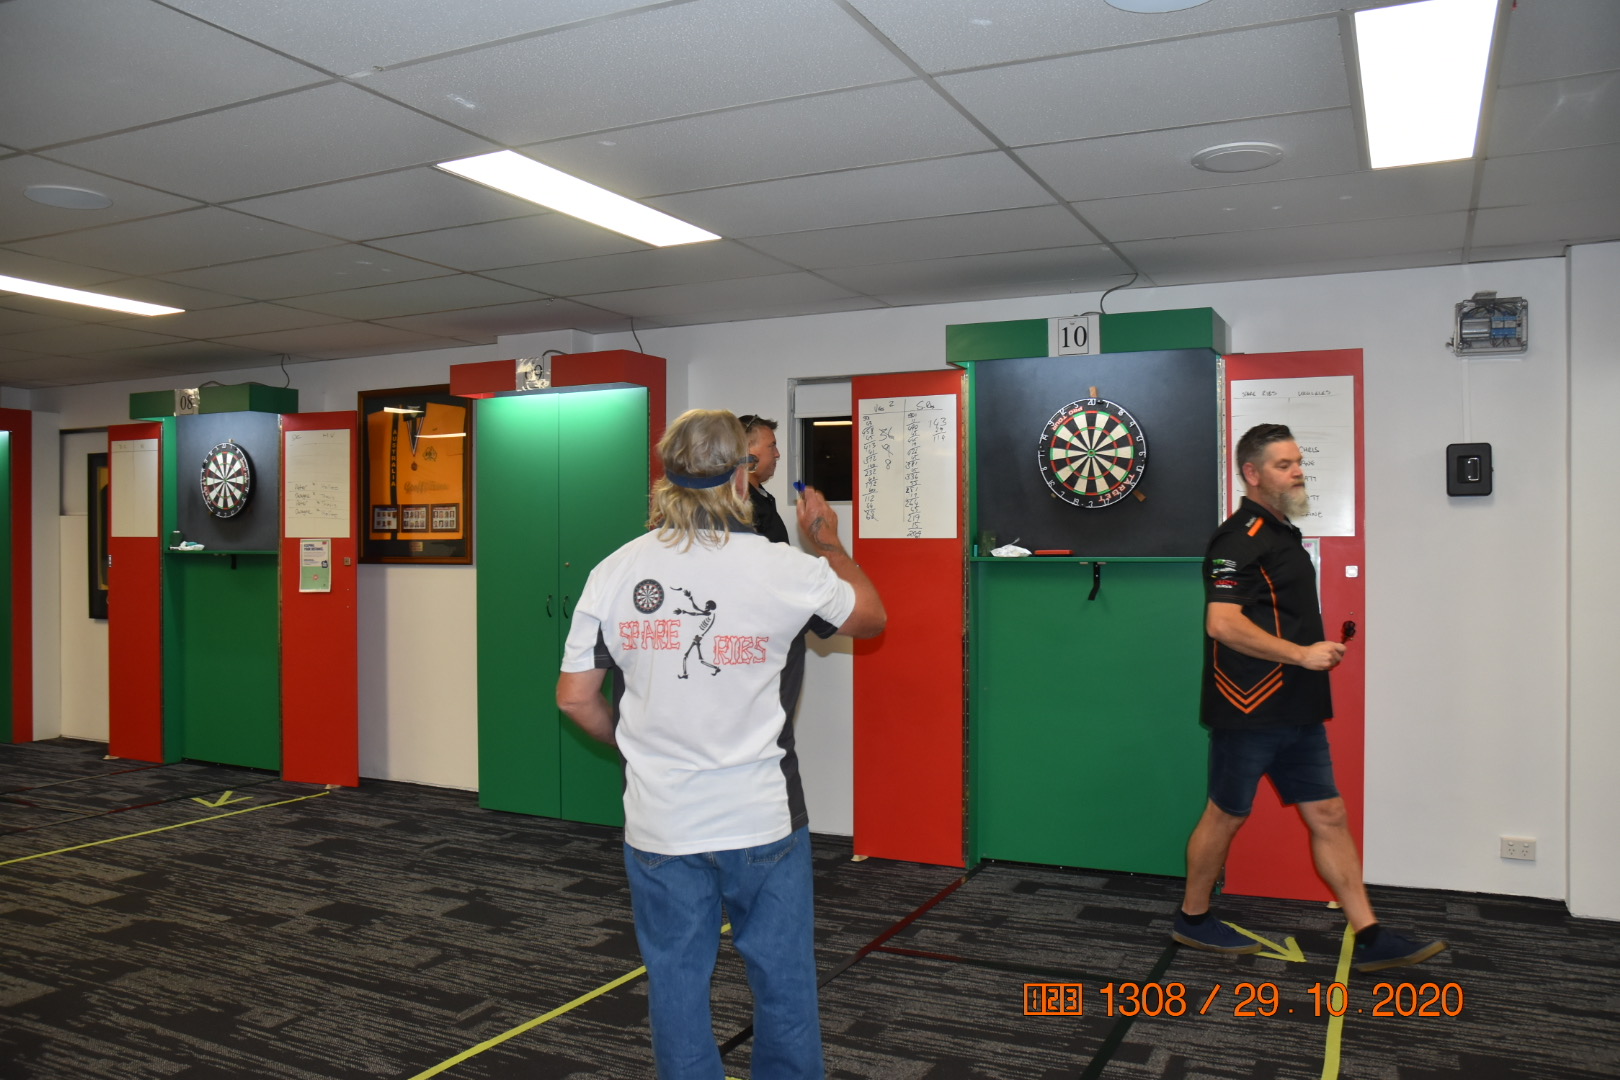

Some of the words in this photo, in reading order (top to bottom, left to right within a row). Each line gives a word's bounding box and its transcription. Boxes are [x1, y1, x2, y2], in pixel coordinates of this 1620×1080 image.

[1062, 326, 1087, 348] 10
[180, 395, 193, 410] 08
[1051, 415, 1067, 431] TOUR
[1098, 474, 1136, 502] TARGET
[619, 619, 681, 650] SPARE
[713, 635, 769, 665] RIBS
